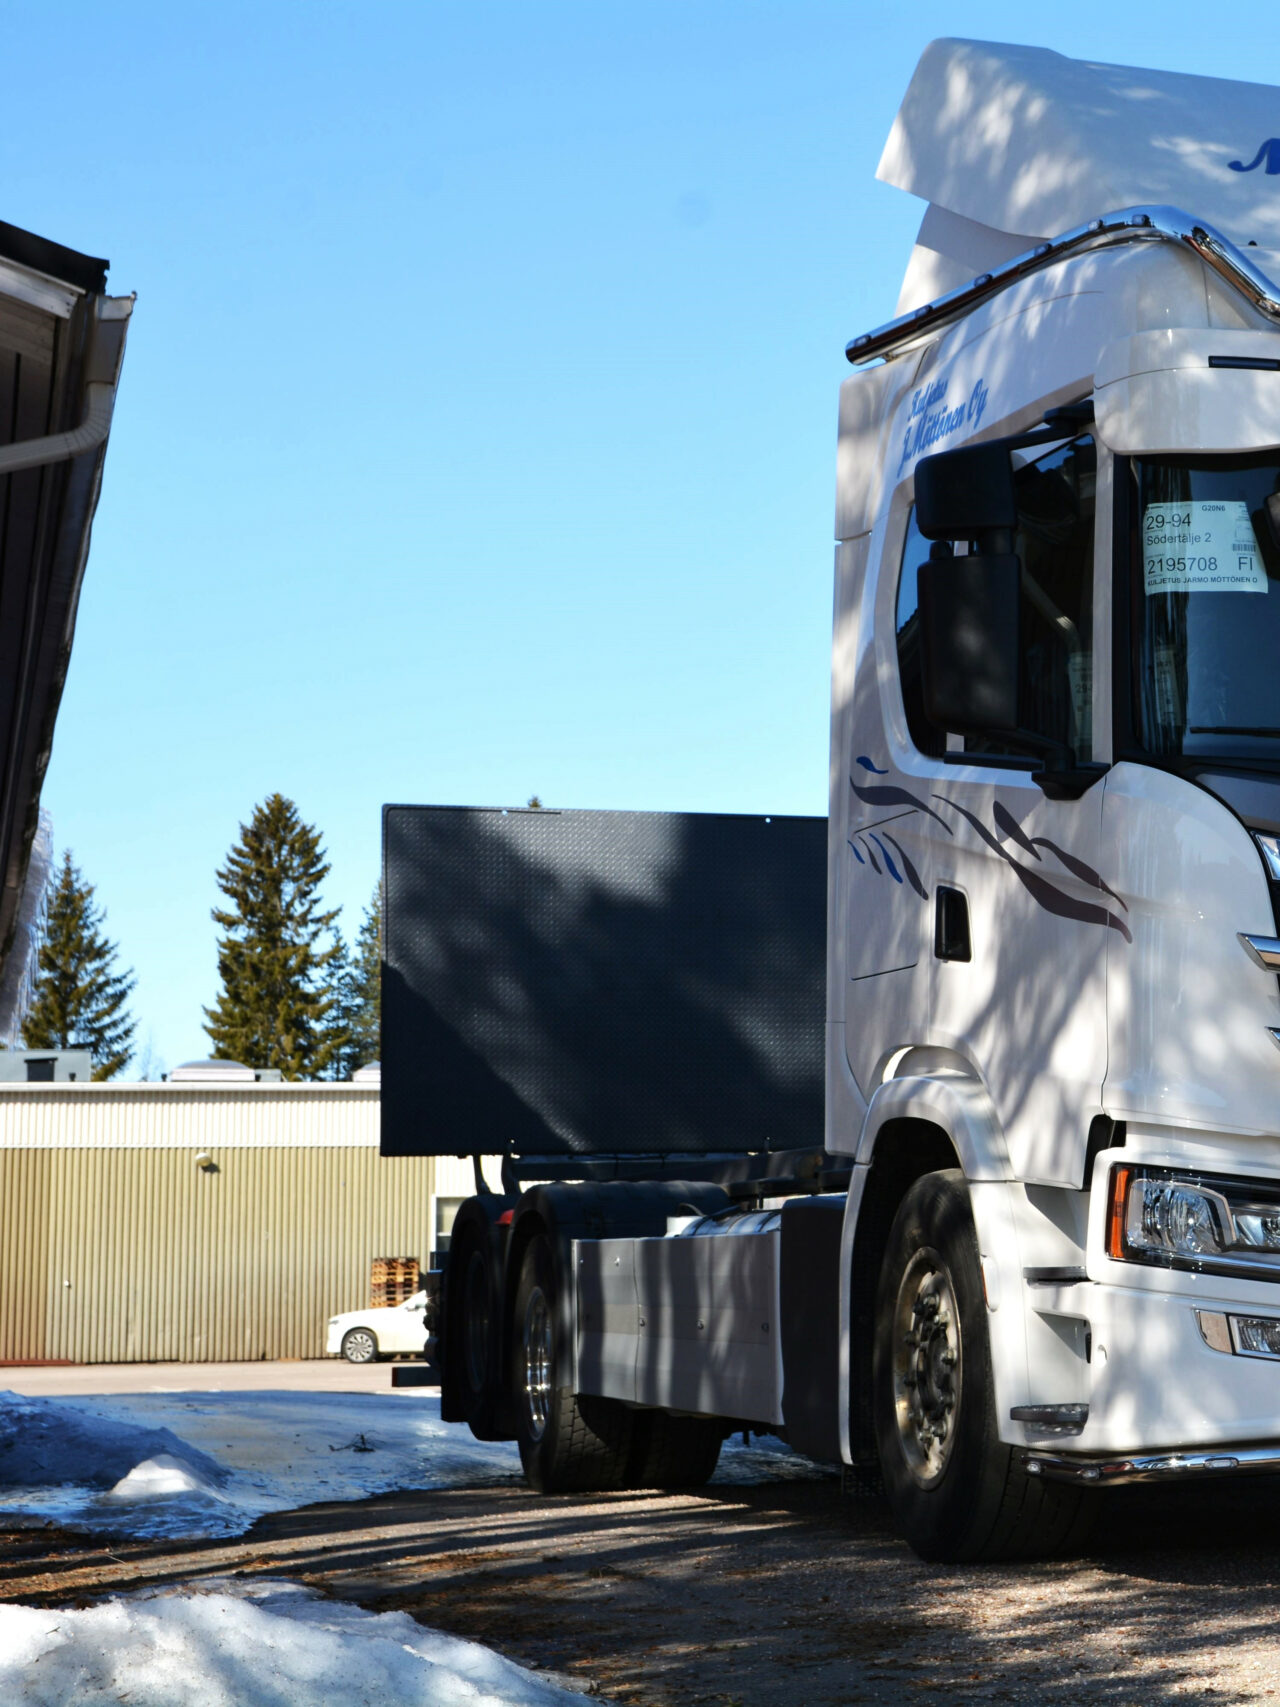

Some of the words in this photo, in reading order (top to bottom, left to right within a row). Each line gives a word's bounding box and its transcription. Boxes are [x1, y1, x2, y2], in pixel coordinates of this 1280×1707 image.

[912, 402, 966, 457] Möttönen
[966, 378, 989, 430] Oy
[1146, 513, 1191, 530] 29-94
[1204, 532, 1212, 543] 2
[1147, 557, 1218, 575] 2195708
[1238, 557, 1253, 571] FI
